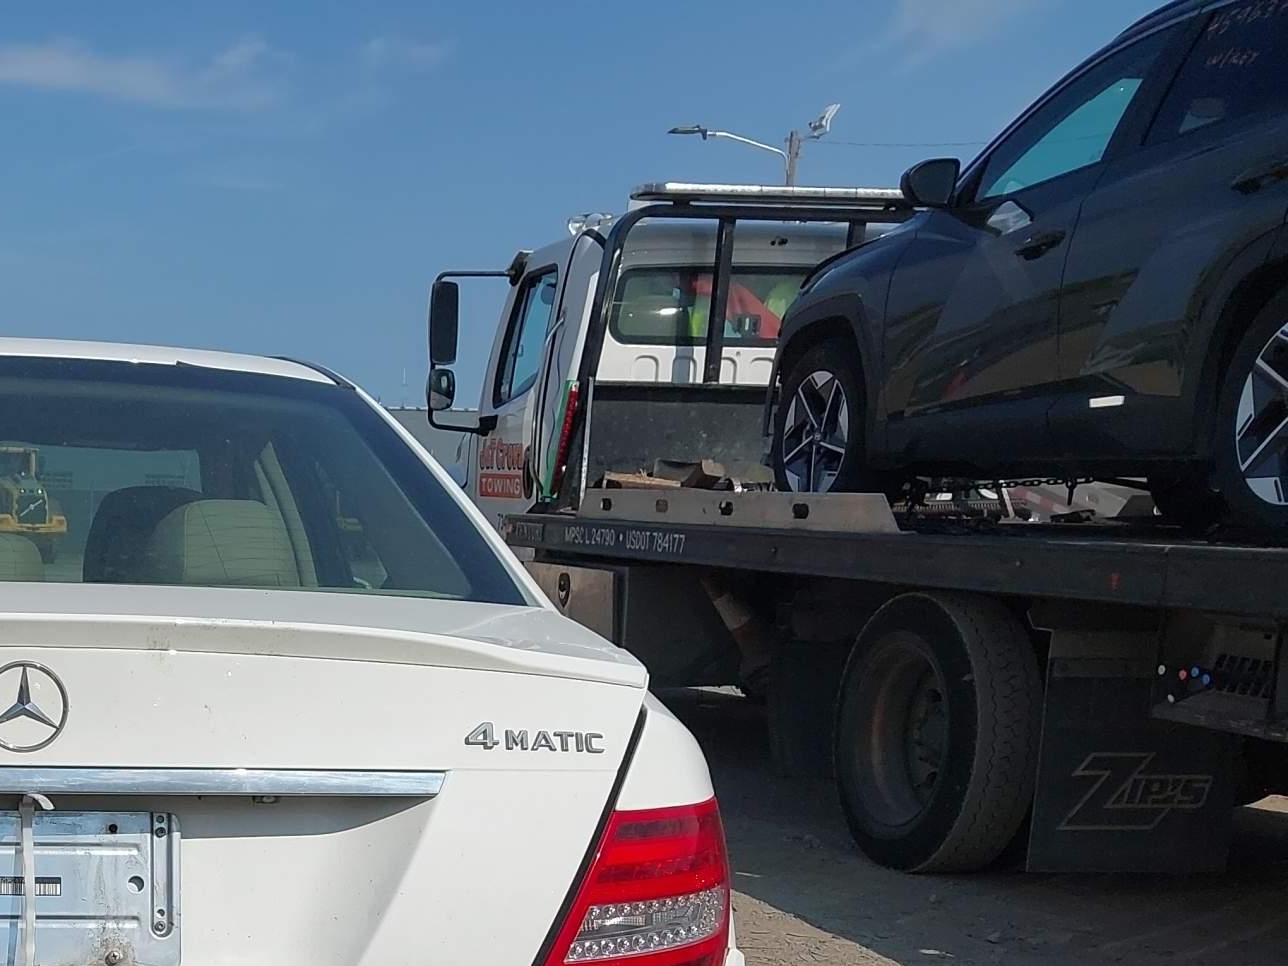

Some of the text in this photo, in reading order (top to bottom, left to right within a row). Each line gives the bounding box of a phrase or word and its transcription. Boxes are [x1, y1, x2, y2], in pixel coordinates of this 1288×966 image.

[481, 478, 521, 495] TOWING
[565, 526, 584, 544] MPSC
[591, 528, 615, 546] 24790
[626, 530, 650, 550] USDOT
[652, 532, 686, 554] 784177
